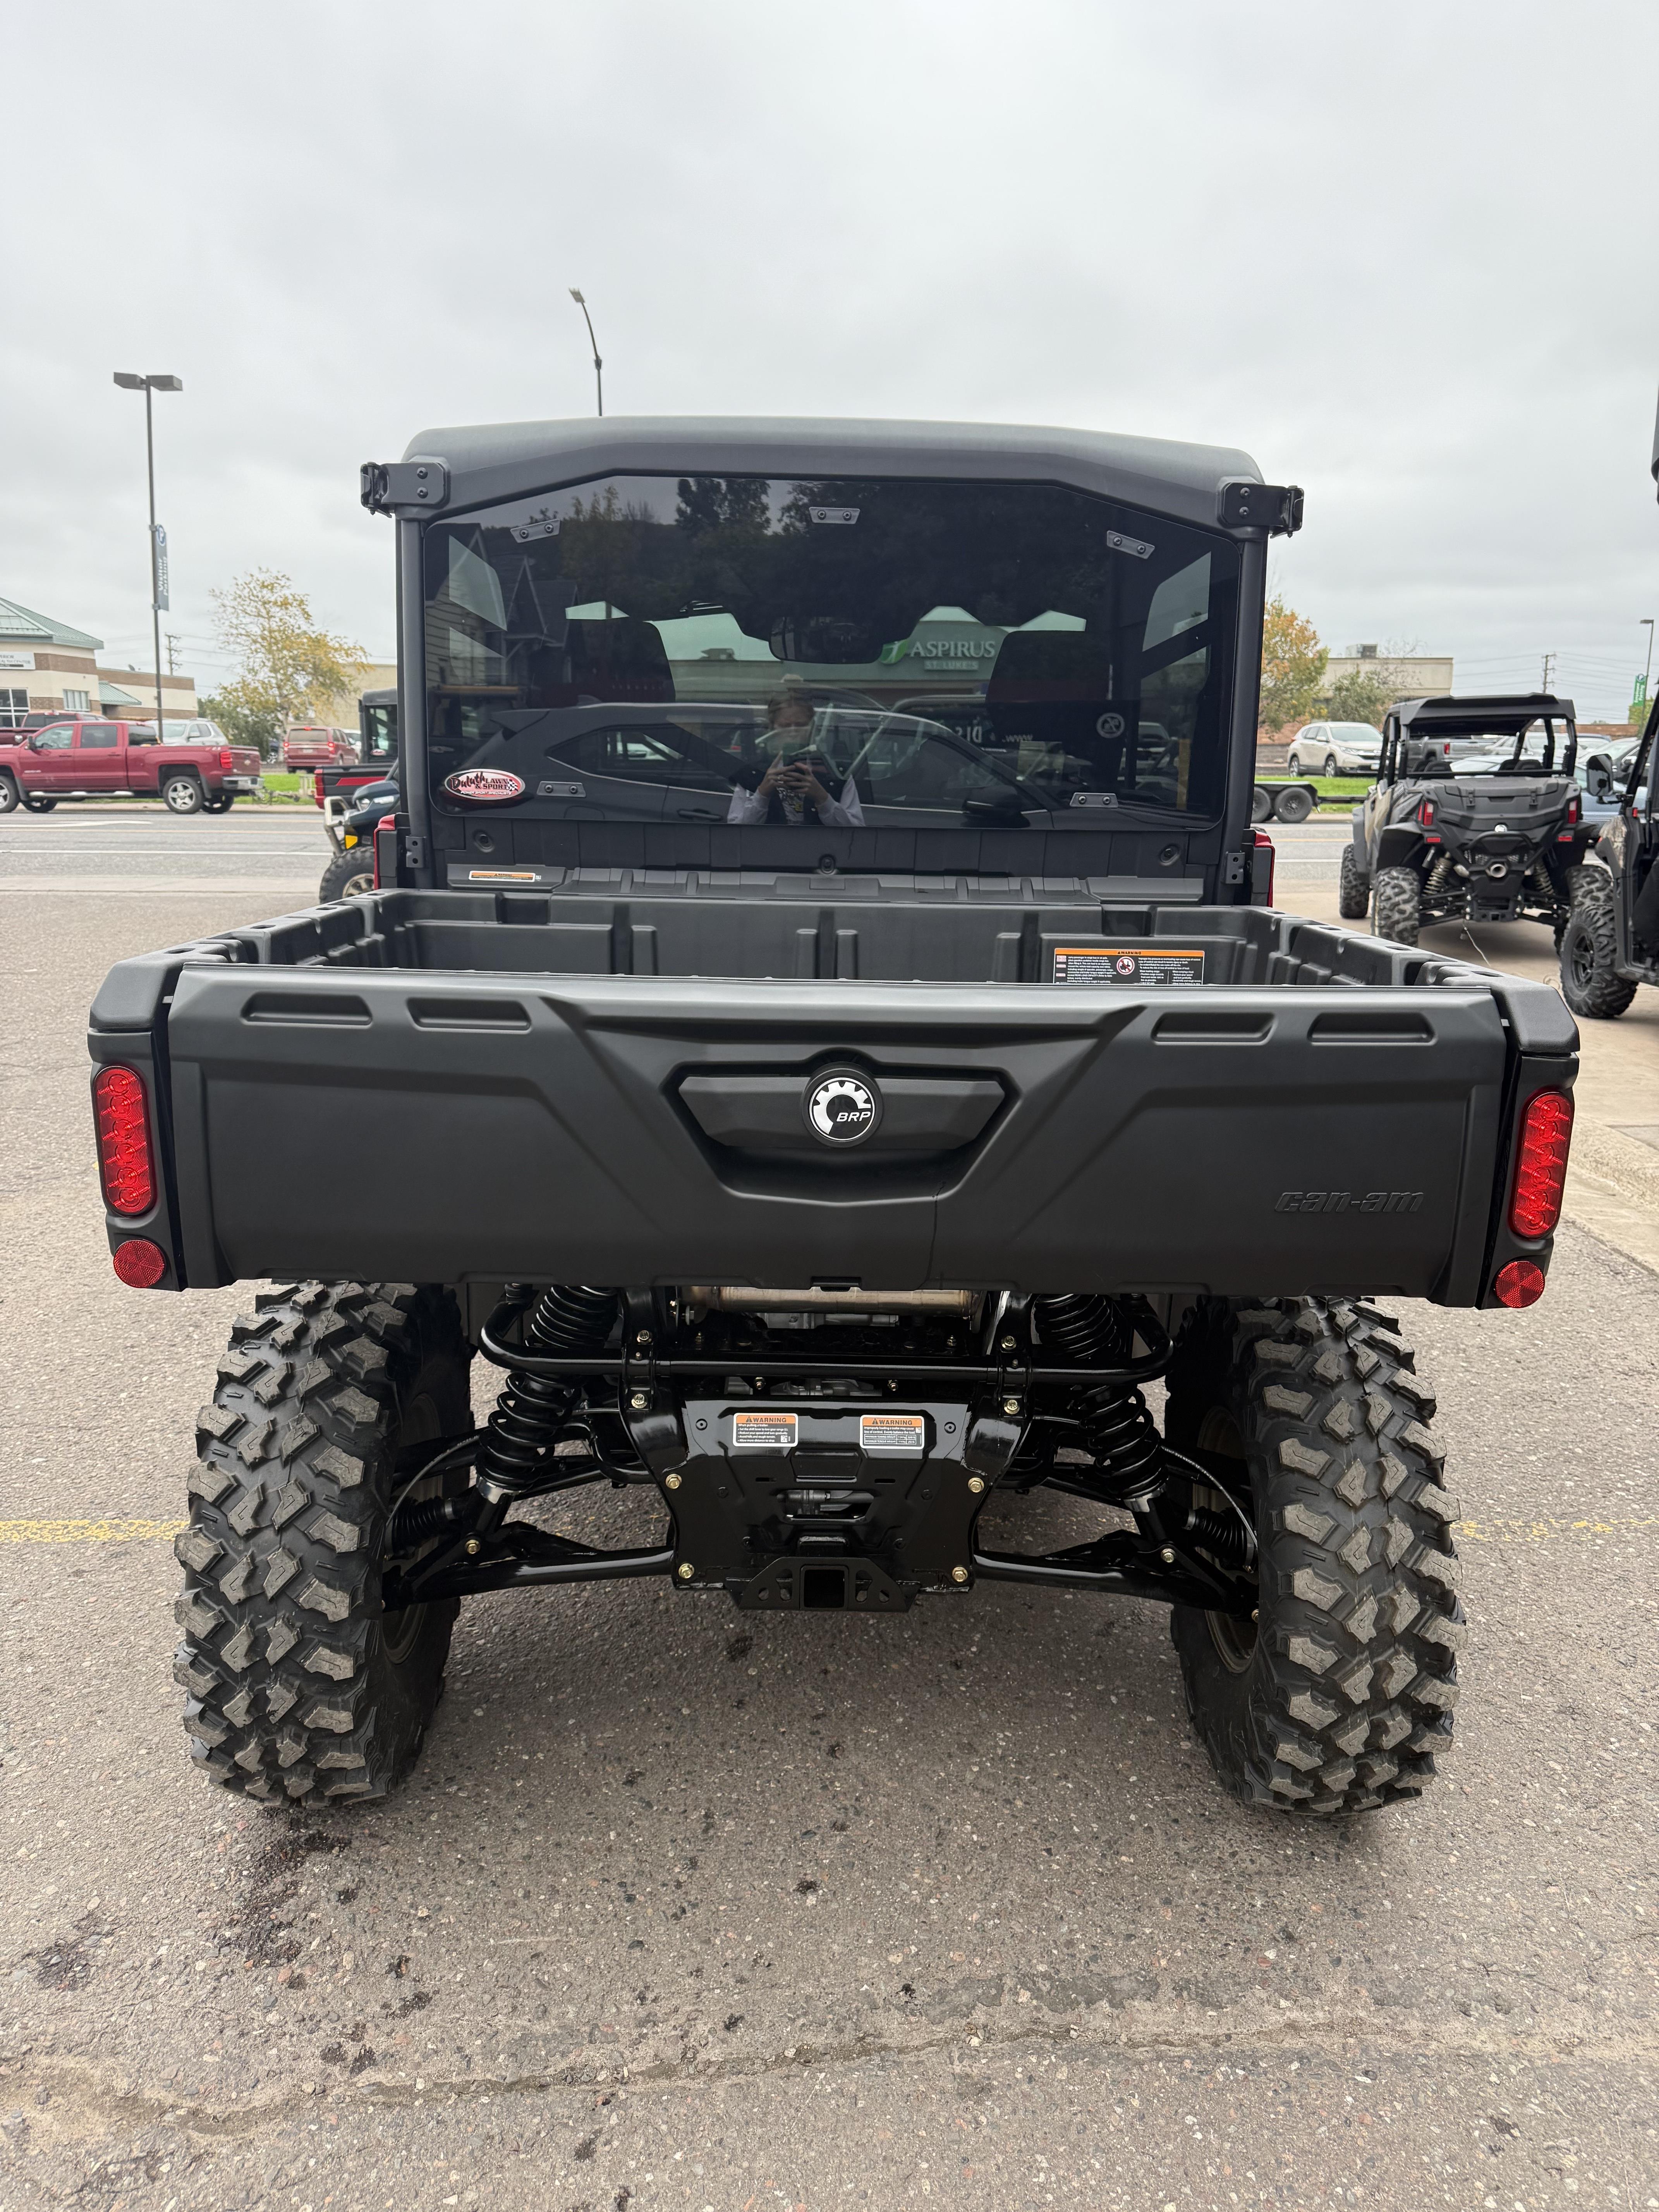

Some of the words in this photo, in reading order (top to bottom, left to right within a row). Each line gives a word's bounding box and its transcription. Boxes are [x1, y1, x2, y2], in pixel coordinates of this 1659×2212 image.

[910, 641, 996, 657] ASPIRUS
[925, 661, 941, 669] ST.
[450, 771, 485, 790] Duluth
[836, 1111, 871, 1122] BRP
[1274, 1192, 1424, 1212] can-am
